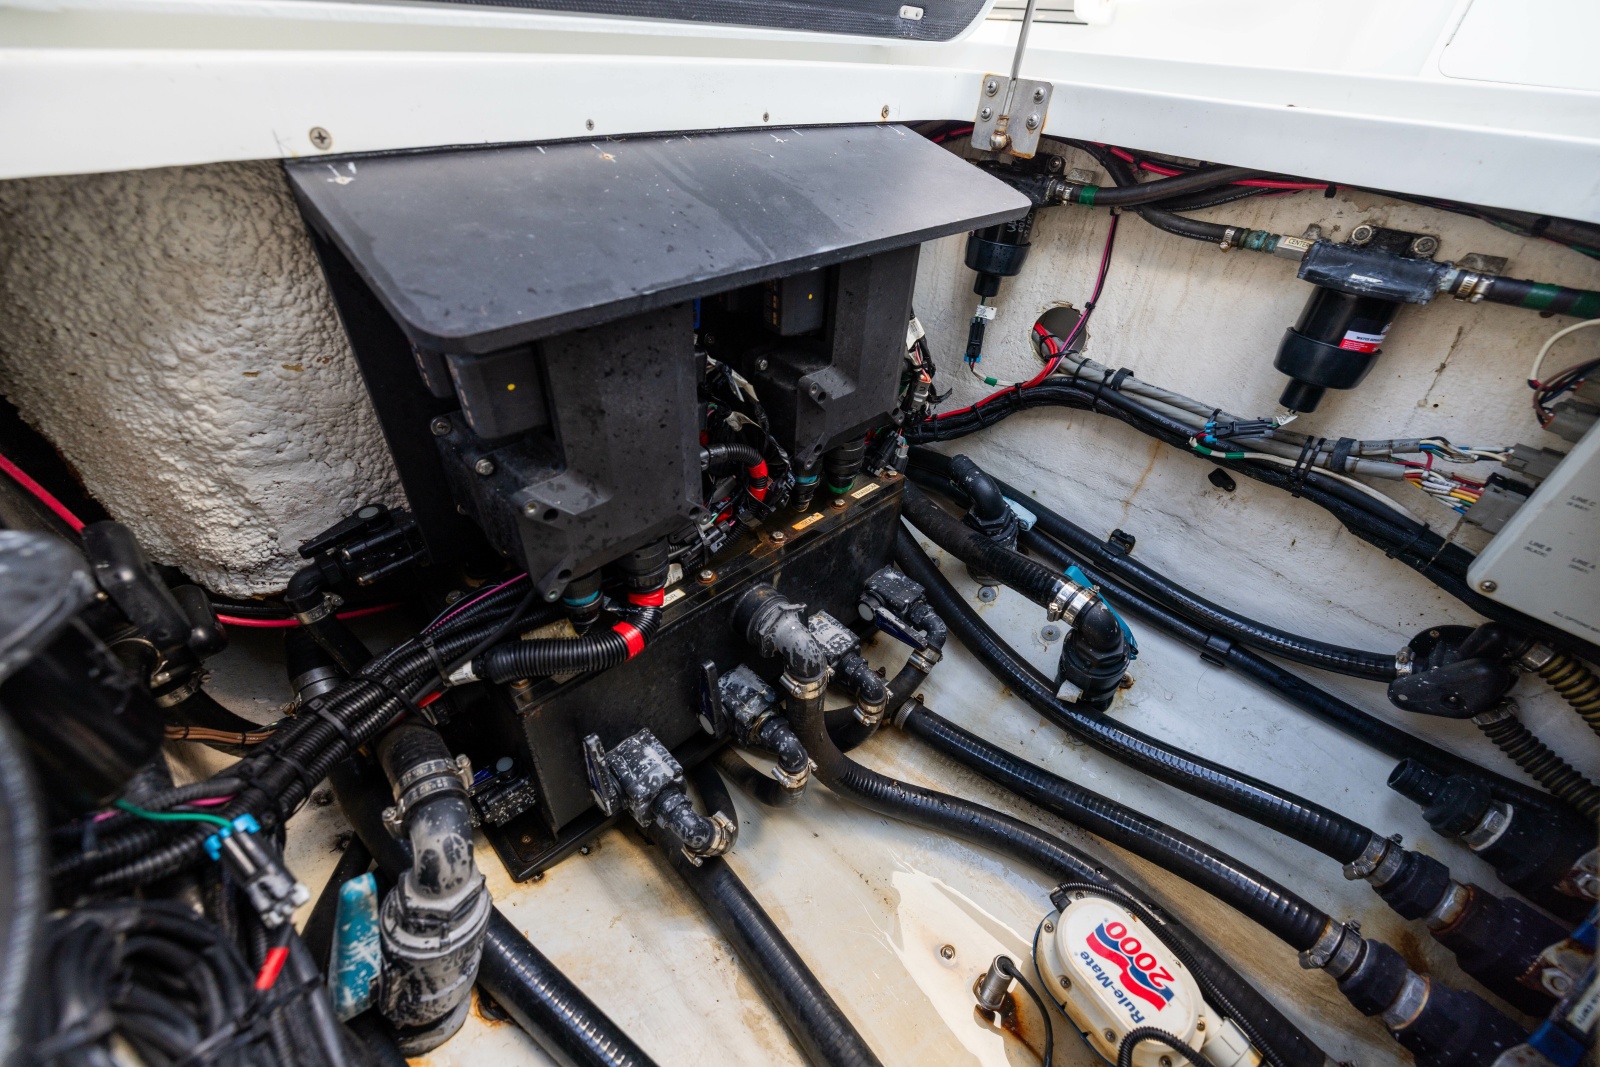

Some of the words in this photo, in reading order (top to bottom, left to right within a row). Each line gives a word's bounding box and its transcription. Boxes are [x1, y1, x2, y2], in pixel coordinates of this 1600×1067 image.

[1288, 239, 1310, 248] CENTER
[1080, 951, 1146, 1024] Rule-Mate
[1105, 922, 1176, 988] 2000
